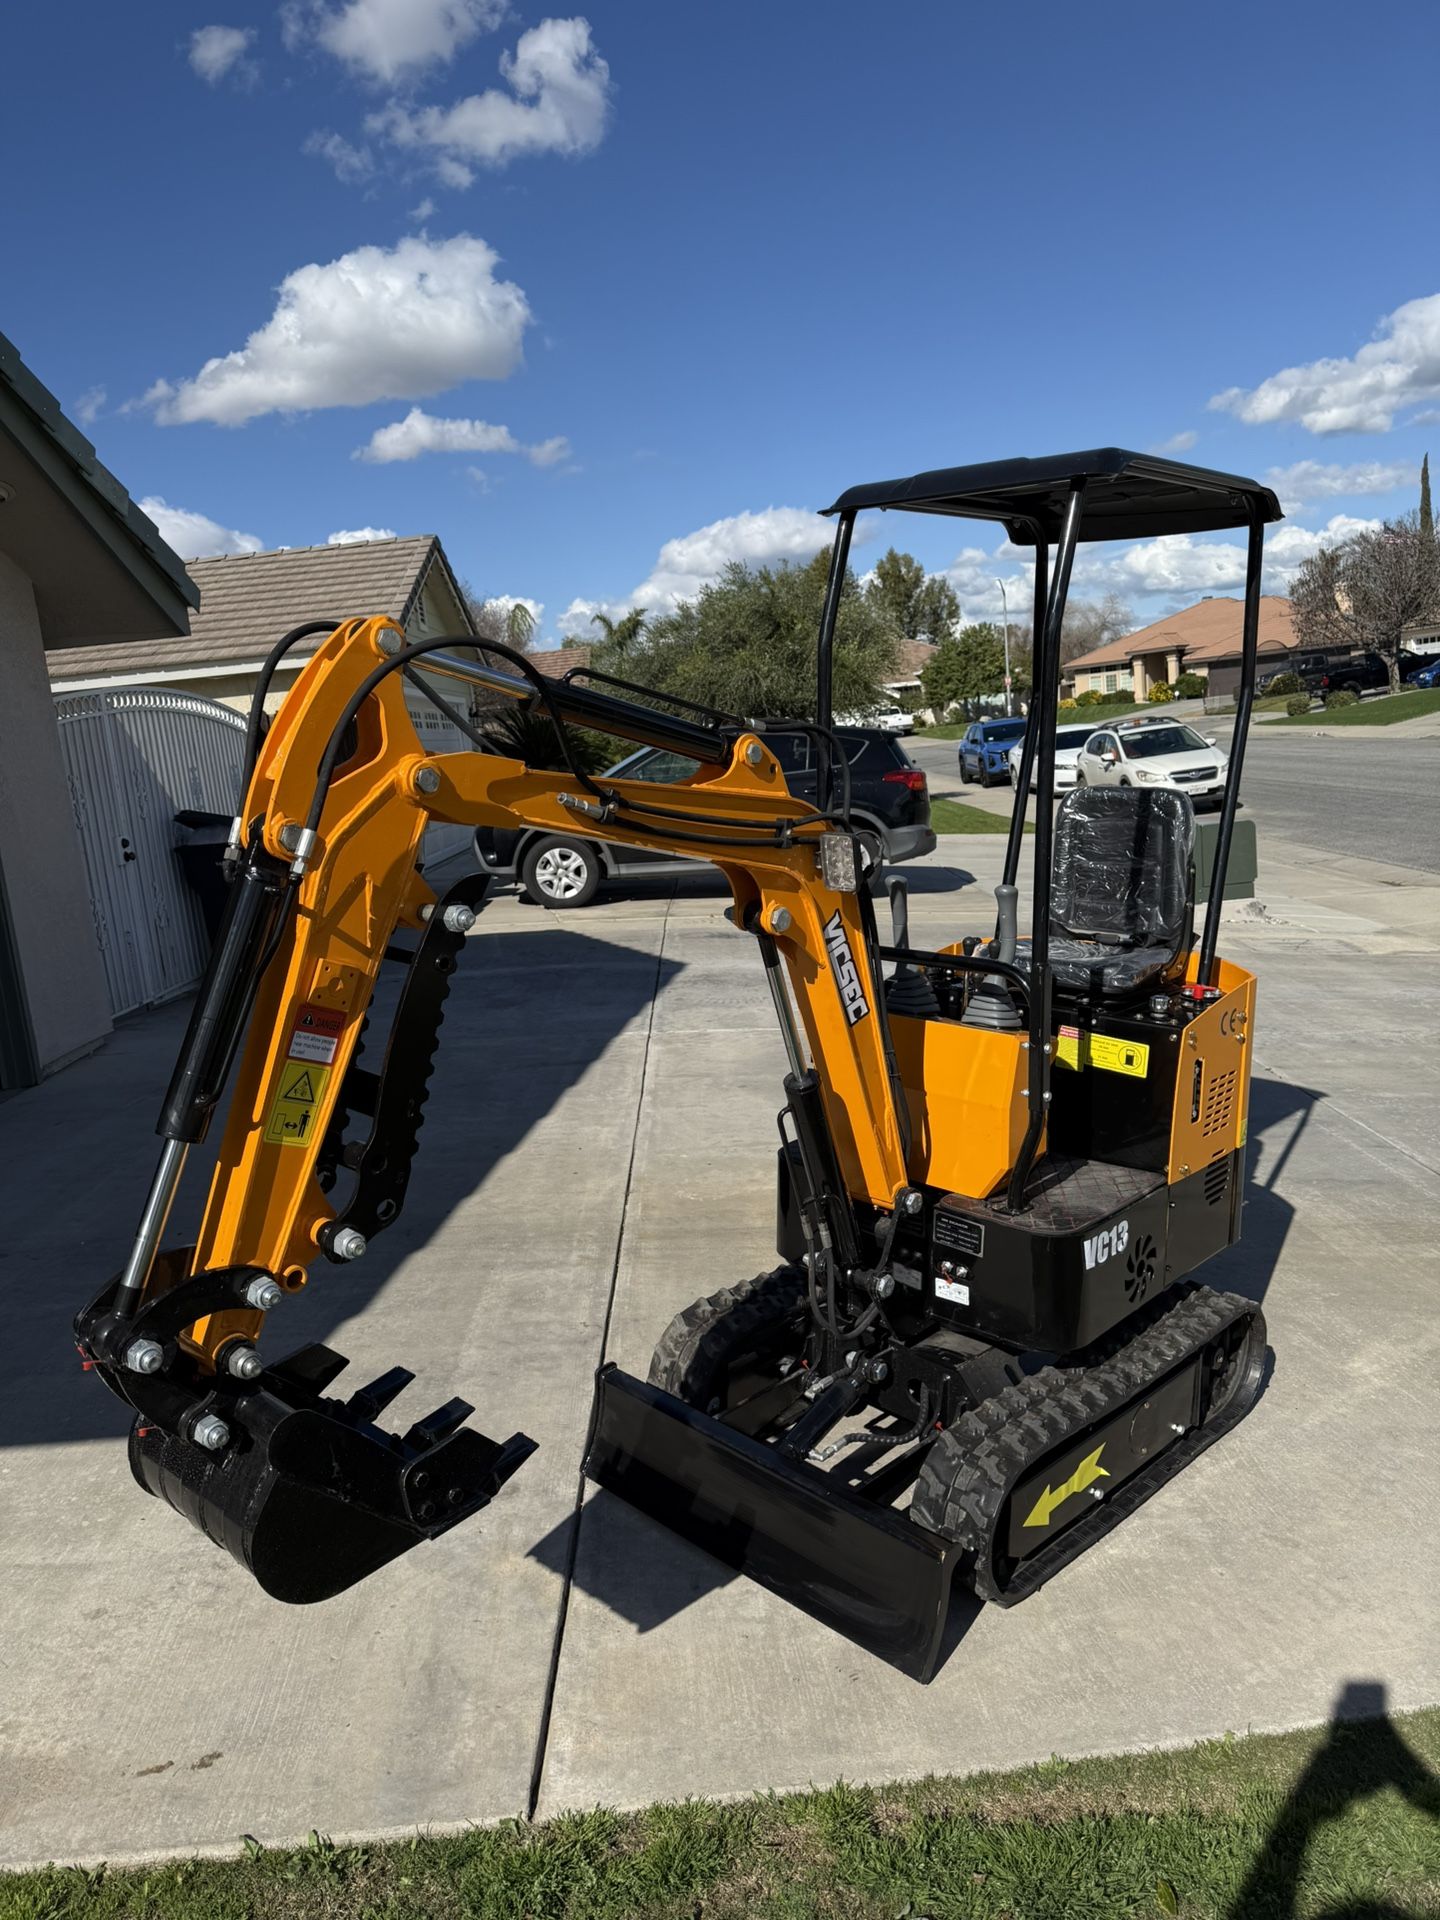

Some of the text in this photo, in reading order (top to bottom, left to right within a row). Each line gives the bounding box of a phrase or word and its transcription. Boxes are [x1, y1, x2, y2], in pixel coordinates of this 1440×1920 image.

[824, 909, 870, 1026] VICSEC
[315, 1017, 340, 1031] DANGER
[1083, 1220, 1129, 1271] VC13
